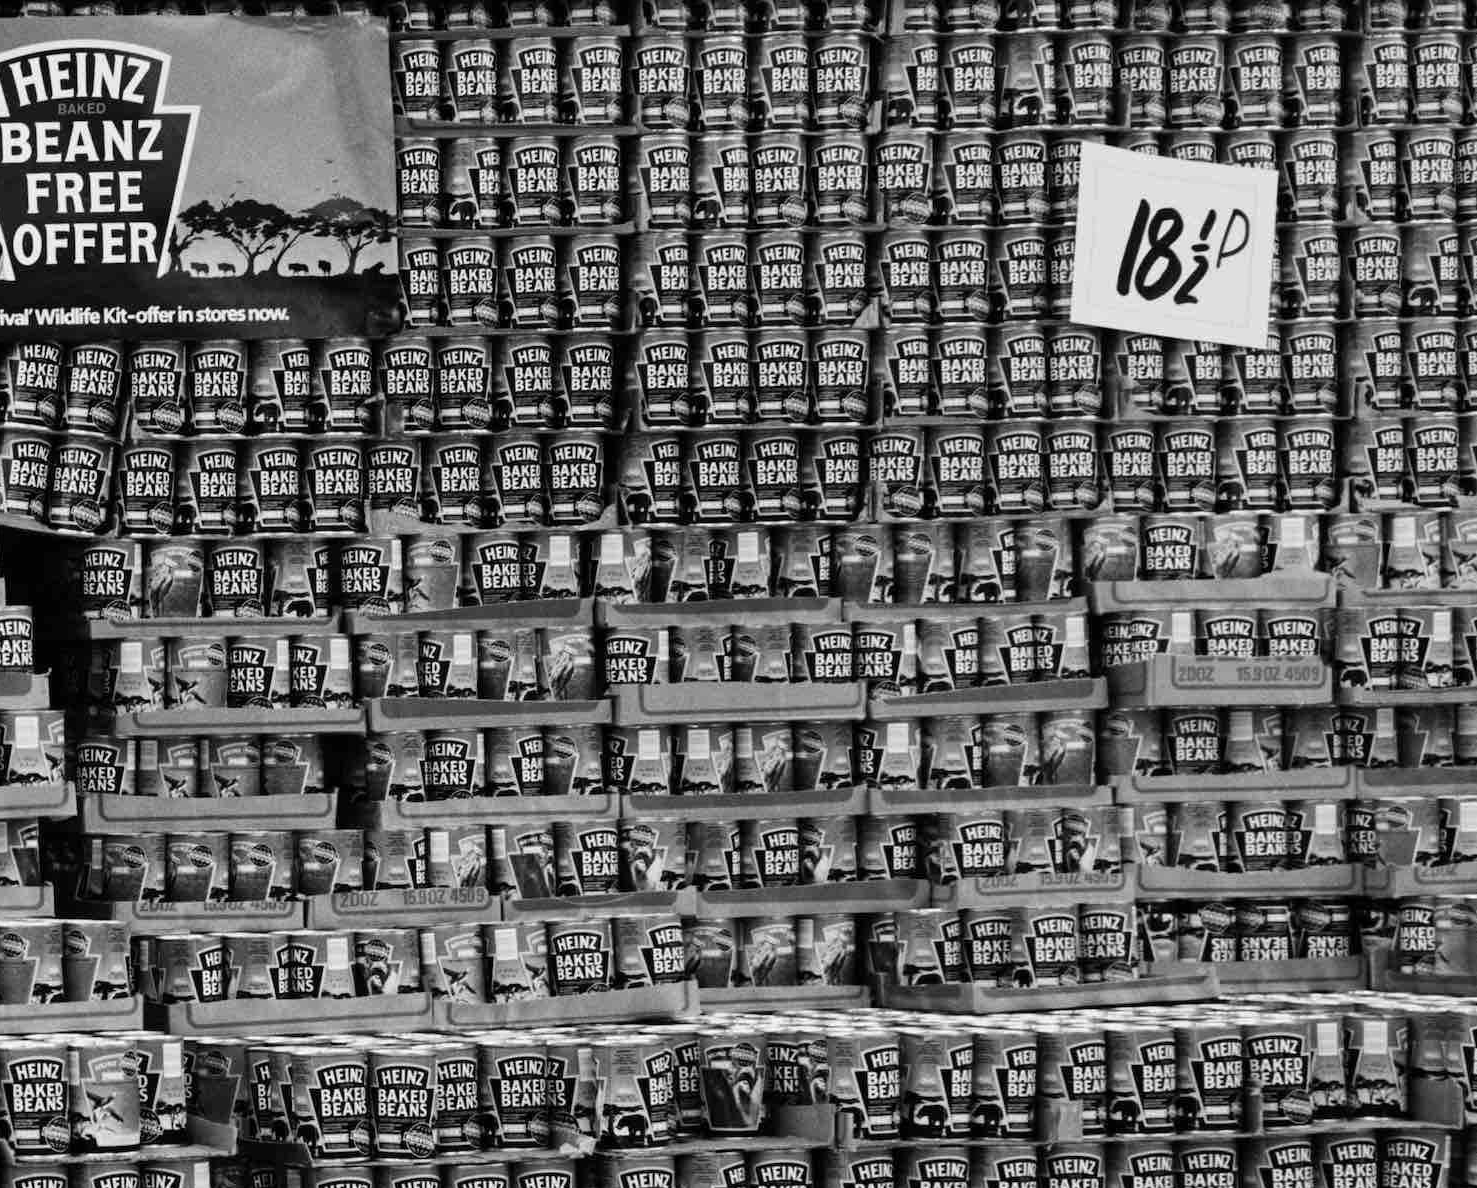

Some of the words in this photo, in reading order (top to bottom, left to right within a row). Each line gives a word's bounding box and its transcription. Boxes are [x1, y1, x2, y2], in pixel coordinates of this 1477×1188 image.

[9, 51, 150, 107] HEINZ
[57, 102, 107, 116] BAKED
[0, 119, 164, 165] BEANZ
[25, 170, 144, 215] FREE
[13, 222, 158, 266] OFFER
[1360, 239, 1397, 254] HEINZ
[454, 251, 491, 266] HEINZ
[1357, 256, 1399, 269] BAKED
[451, 268, 493, 281] BAKED
[1357, 269, 1398, 281] BEANS
[451, 281, 492, 293] BEANS
[35, 307, 100, 325] Wildlife
[103, 305, 175, 324] Kit-offer
[177, 305, 193, 323] in
[196, 306, 245, 322] stores
[248, 307, 290, 322] now.
[822, 343, 861, 358] HEINZ
[199, 354, 235, 368] HEINZ
[819, 360, 864, 373] BAKED
[195, 372, 239, 384] BAKED
[819, 373, 863, 385] BEANS
[195, 384, 239, 397] BEANS
[555, 446, 594, 461] HEINZ
[552, 463, 597, 476] BAKED
[552, 476, 596, 488] BEANS
[1151, 528, 1188, 542] HEINZ
[1147, 545, 1192, 557] BAKED
[216, 552, 255, 567] HEINZ
[1147, 557, 1192, 570] BEANS
[213, 569, 258, 582] BAKED
[213, 582, 257, 594] BEANS
[17, 1062, 60, 1080] HEINZ
[15, 1082, 64, 1098] BAKED
[16, 1097, 64, 1112] BEANS
[1053, 1158, 1097, 1176] HEINZ
